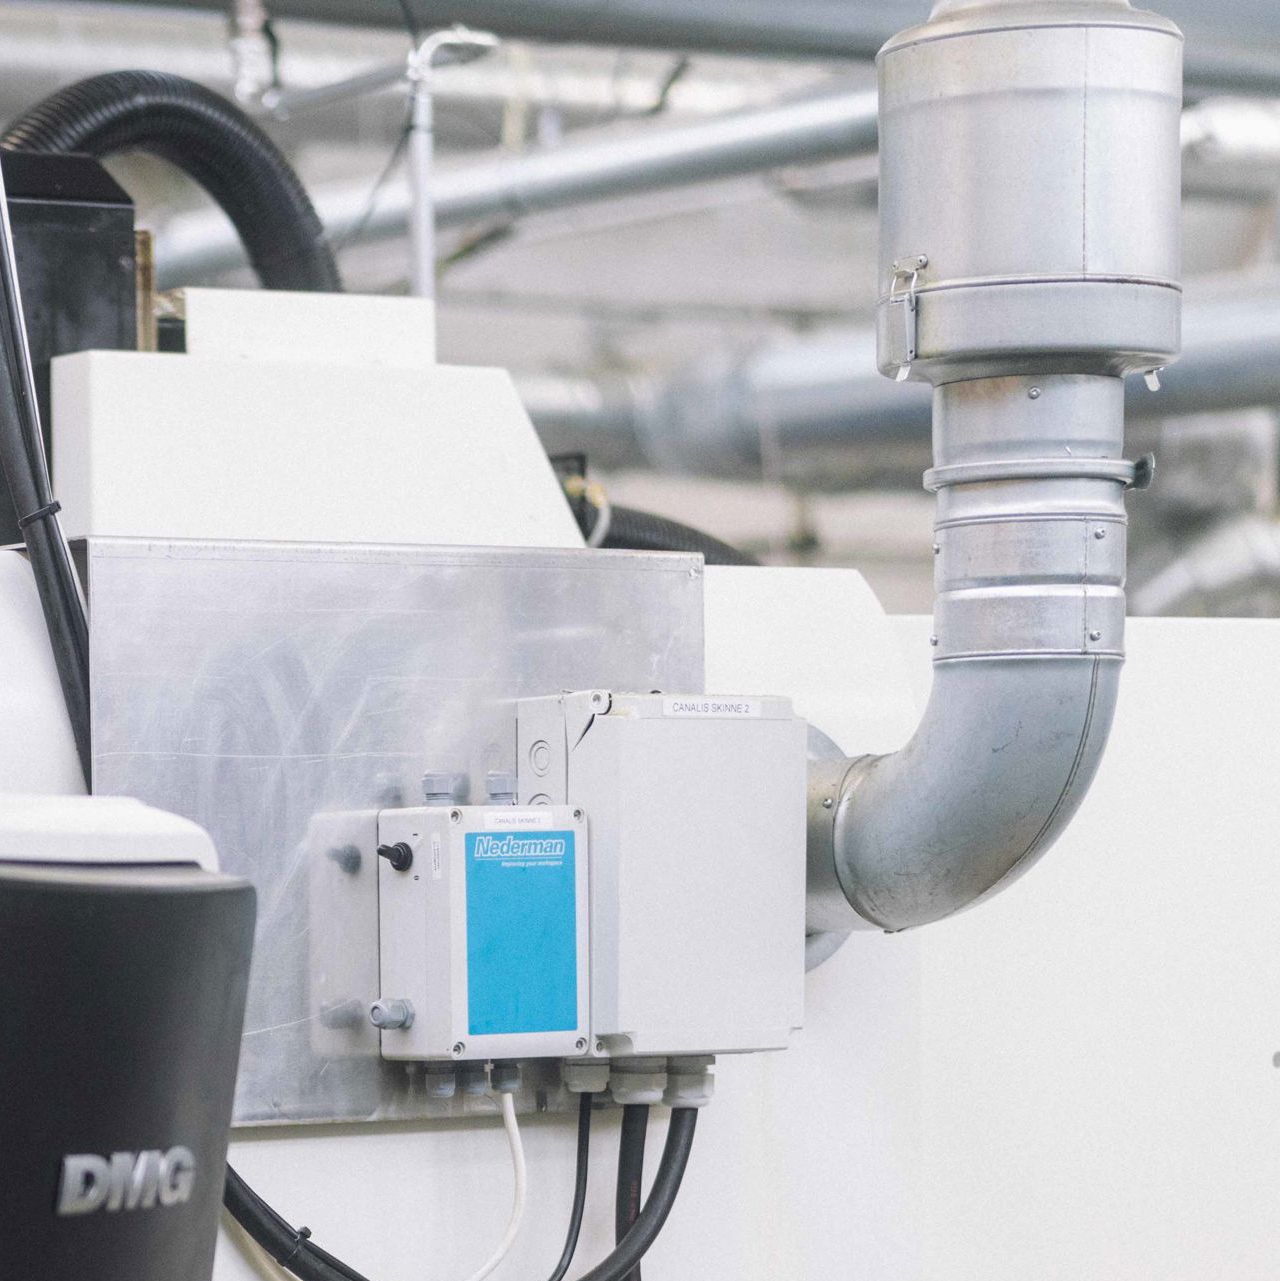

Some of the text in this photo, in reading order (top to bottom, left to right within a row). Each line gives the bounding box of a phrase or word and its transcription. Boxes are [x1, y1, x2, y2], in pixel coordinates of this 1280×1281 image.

[672, 702, 750, 713] CANALIS SKINNE 2
[475, 836, 565, 856] Nederman
[57, 1145, 195, 1215] DMG
